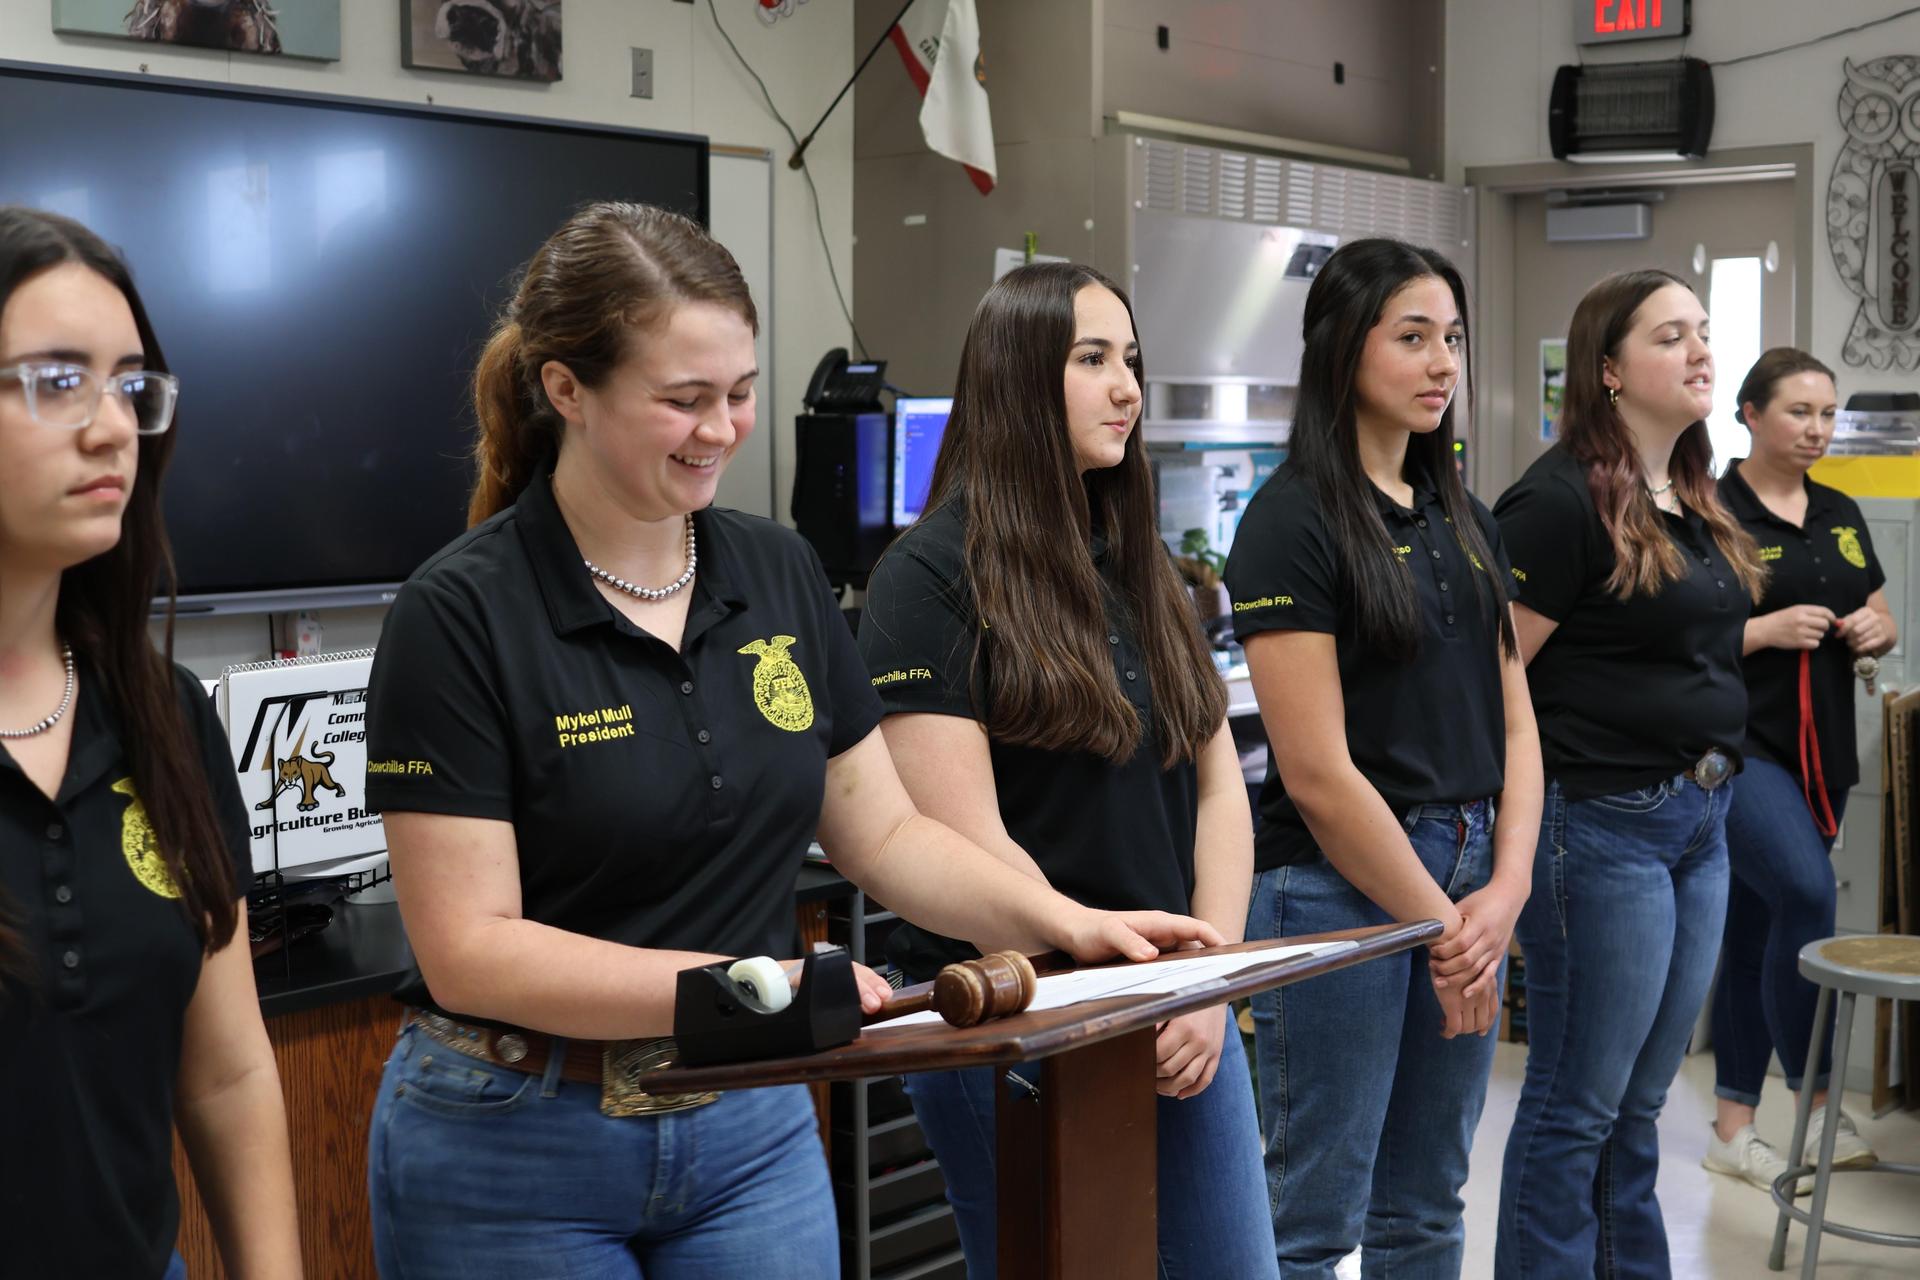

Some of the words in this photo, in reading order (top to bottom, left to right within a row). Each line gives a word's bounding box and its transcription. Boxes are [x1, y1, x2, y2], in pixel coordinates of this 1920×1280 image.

[1889, 171, 1910, 325] WELCOME
[1234, 597, 1273, 611] Chowchilla
[1275, 596, 1293, 606] FFA
[872, 671, 907, 686] owchilla
[909, 669, 932, 679] FFA
[332, 691, 368, 706] Made
[328, 712, 366, 725] Comm
[555, 709, 601, 732] Mykel
[601, 704, 633, 723] Mull
[323, 730, 367, 744] Colleg
[559, 722, 635, 748] President
[407, 760, 433, 775] FFA
[249, 812, 343, 839] griculture
[323, 823, 353, 833] Growing
[355, 818, 383, 830] Agricult
